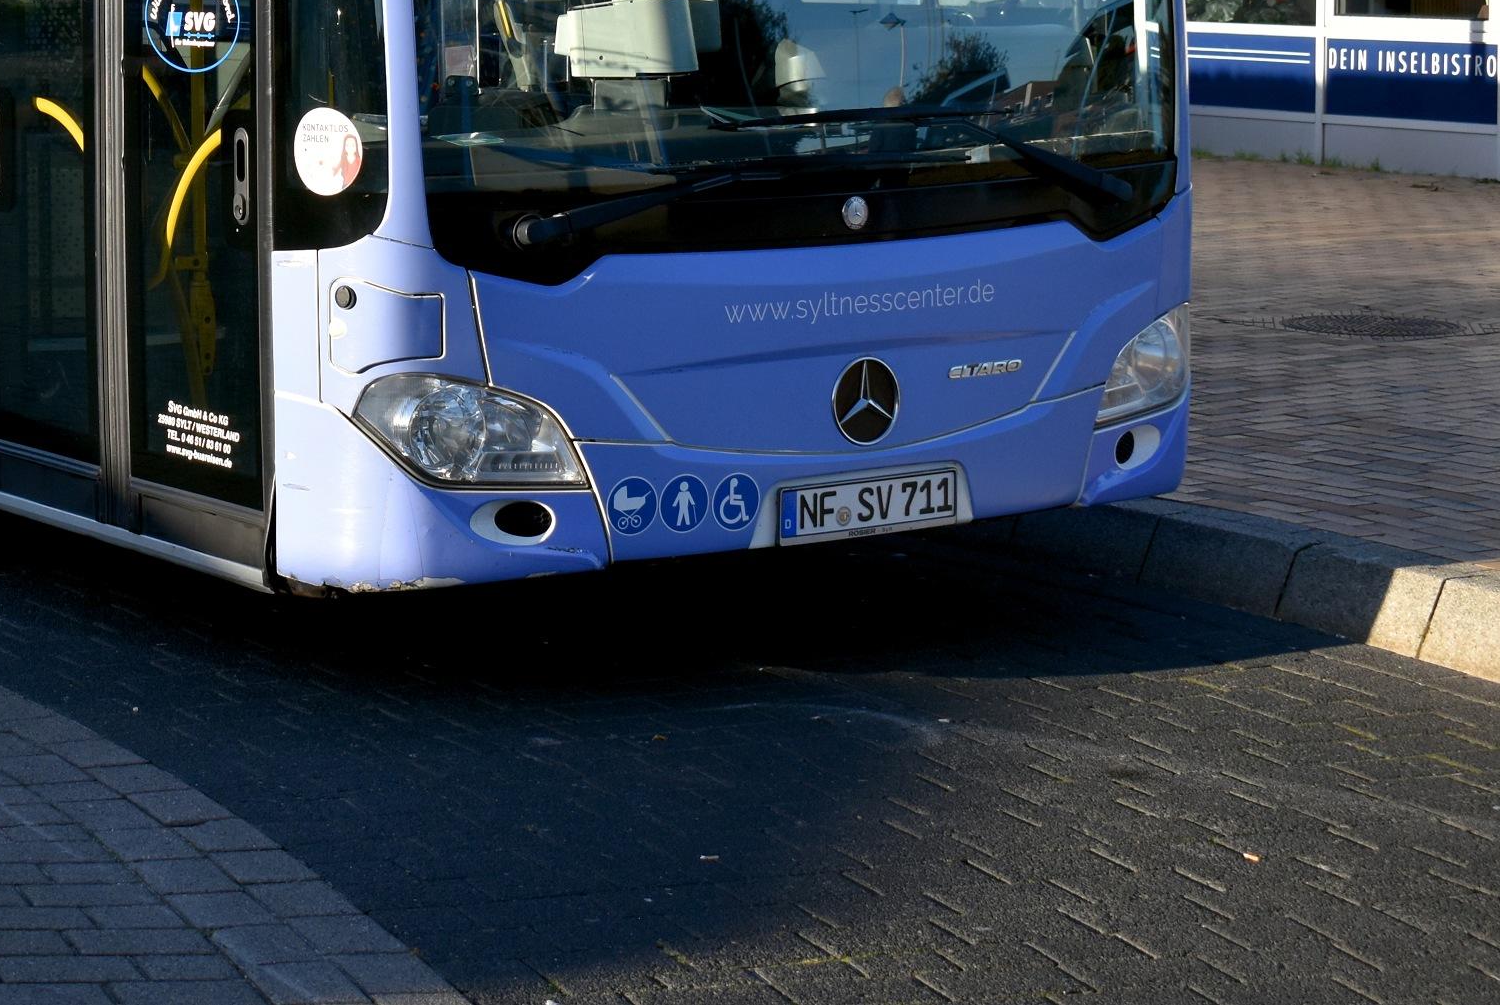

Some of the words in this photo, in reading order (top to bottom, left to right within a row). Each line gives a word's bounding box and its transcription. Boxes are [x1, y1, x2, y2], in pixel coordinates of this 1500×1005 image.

[183, 10, 216, 32] SVG
[1327, 47, 1368, 71] DEIN
[1377, 49, 1498, 78] INSELBISTRO
[302, 123, 349, 133] KONTAKTLOS
[302, 134, 329, 143] ZAHLEN
[724, 278, 996, 325] www.syltnesscenter.de
[947, 358, 1023, 381] CITARO
[168, 400, 182, 414] SVG
[183, 406, 202, 420] GmbH
[209, 412, 218, 423] Co
[219, 415, 228, 426] KG
[176, 418, 192, 430] SYLT
[195, 422, 241, 443] WESTERLAND
[784, 518, 792, 530] D
[799, 489, 838, 530] NF
[856, 483, 893, 523] SV
[901, 476, 953, 517] 711
